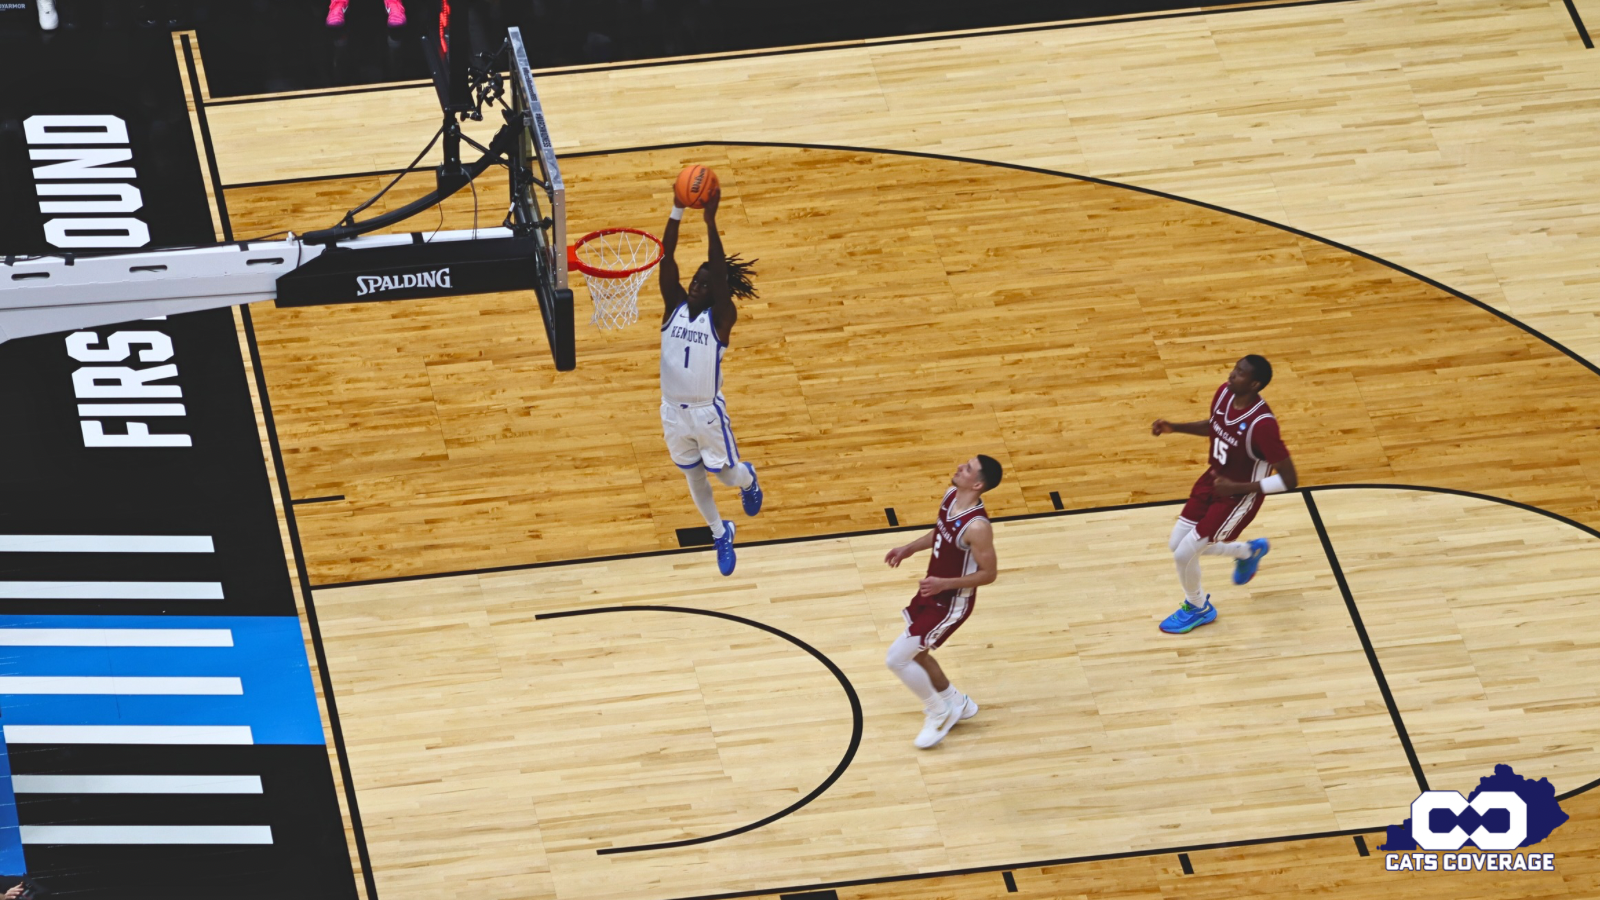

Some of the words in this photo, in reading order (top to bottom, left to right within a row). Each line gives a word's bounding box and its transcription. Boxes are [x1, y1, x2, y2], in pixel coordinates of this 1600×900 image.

[23, 114, 151, 248] OUND
[356, 267, 452, 297] SPALDING
[671, 325, 709, 346] KENUCKY
[684, 346, 690, 369] 1
[65, 315, 192, 447] FIRS
[1213, 437, 1229, 465] 15
[933, 533, 942, 559] 2
